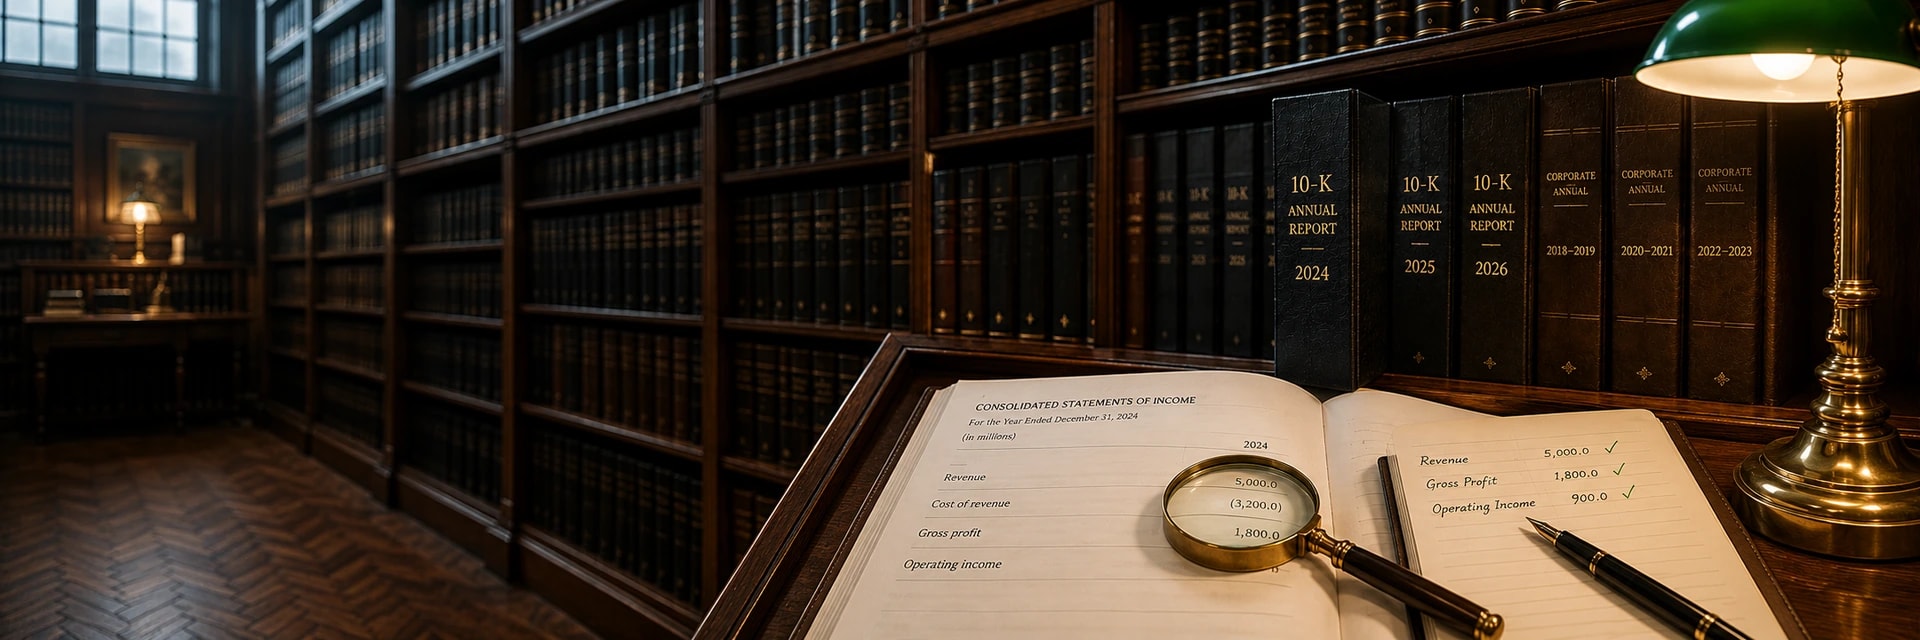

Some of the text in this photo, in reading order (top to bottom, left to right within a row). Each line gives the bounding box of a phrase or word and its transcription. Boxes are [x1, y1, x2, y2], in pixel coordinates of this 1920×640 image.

[1547, 172, 1595, 181] CORPORATE
[1622, 169, 1673, 178] CORPORATE
[1698, 168, 1752, 177] CORPORATE
[1292, 174, 1333, 193] 10-K
[1404, 176, 1440, 192] 10-K
[1474, 174, 1512, 190] 10-K
[1553, 187, 1588, 195] ANNUAL
[1629, 185, 1665, 194] ANNUAL
[1706, 184, 1744, 192] ANNUAL
[1288, 204, 1337, 216] ANNUAL
[1400, 204, 1442, 214] ANNUAL
[1470, 203, 1515, 213] ANNUAL
[1290, 223, 1337, 234] REPORT
[1401, 220, 1441, 231] REPORT
[1471, 220, 1514, 231] REPORT
[1405, 260, 1435, 274] 2025
[1476, 261, 1508, 276] 2026
[1296, 266, 1329, 280] 2024
[976, 401, 1059, 411] CONSOLIDATED
[1062, 398, 1133, 408] STATEMENTS
[968, 411, 1138, 427] For the Year Ended December 31, 2024
[962, 432, 1016, 442] (in millions)
[1244, 441, 1267, 449] 2024
[1545, 448, 1589, 458] 5,000.0
[1420, 456, 1468, 465] Revenue
[1555, 470, 1598, 481] 1,800.0
[1236, 478, 1277, 488] 5,000.0
[1427, 476, 1497, 491] Gross Profit
[932, 499, 1010, 508] Cost of revenue
[1572, 492, 1607, 504] 900.0
[1230, 499, 1282, 513] (3,200.0)
[1433, 500, 1535, 518] Operating Income
[919, 528, 981, 539] Gross profit
[1235, 528, 1279, 541] 1,800.0
[904, 560, 1002, 571] Operating income
